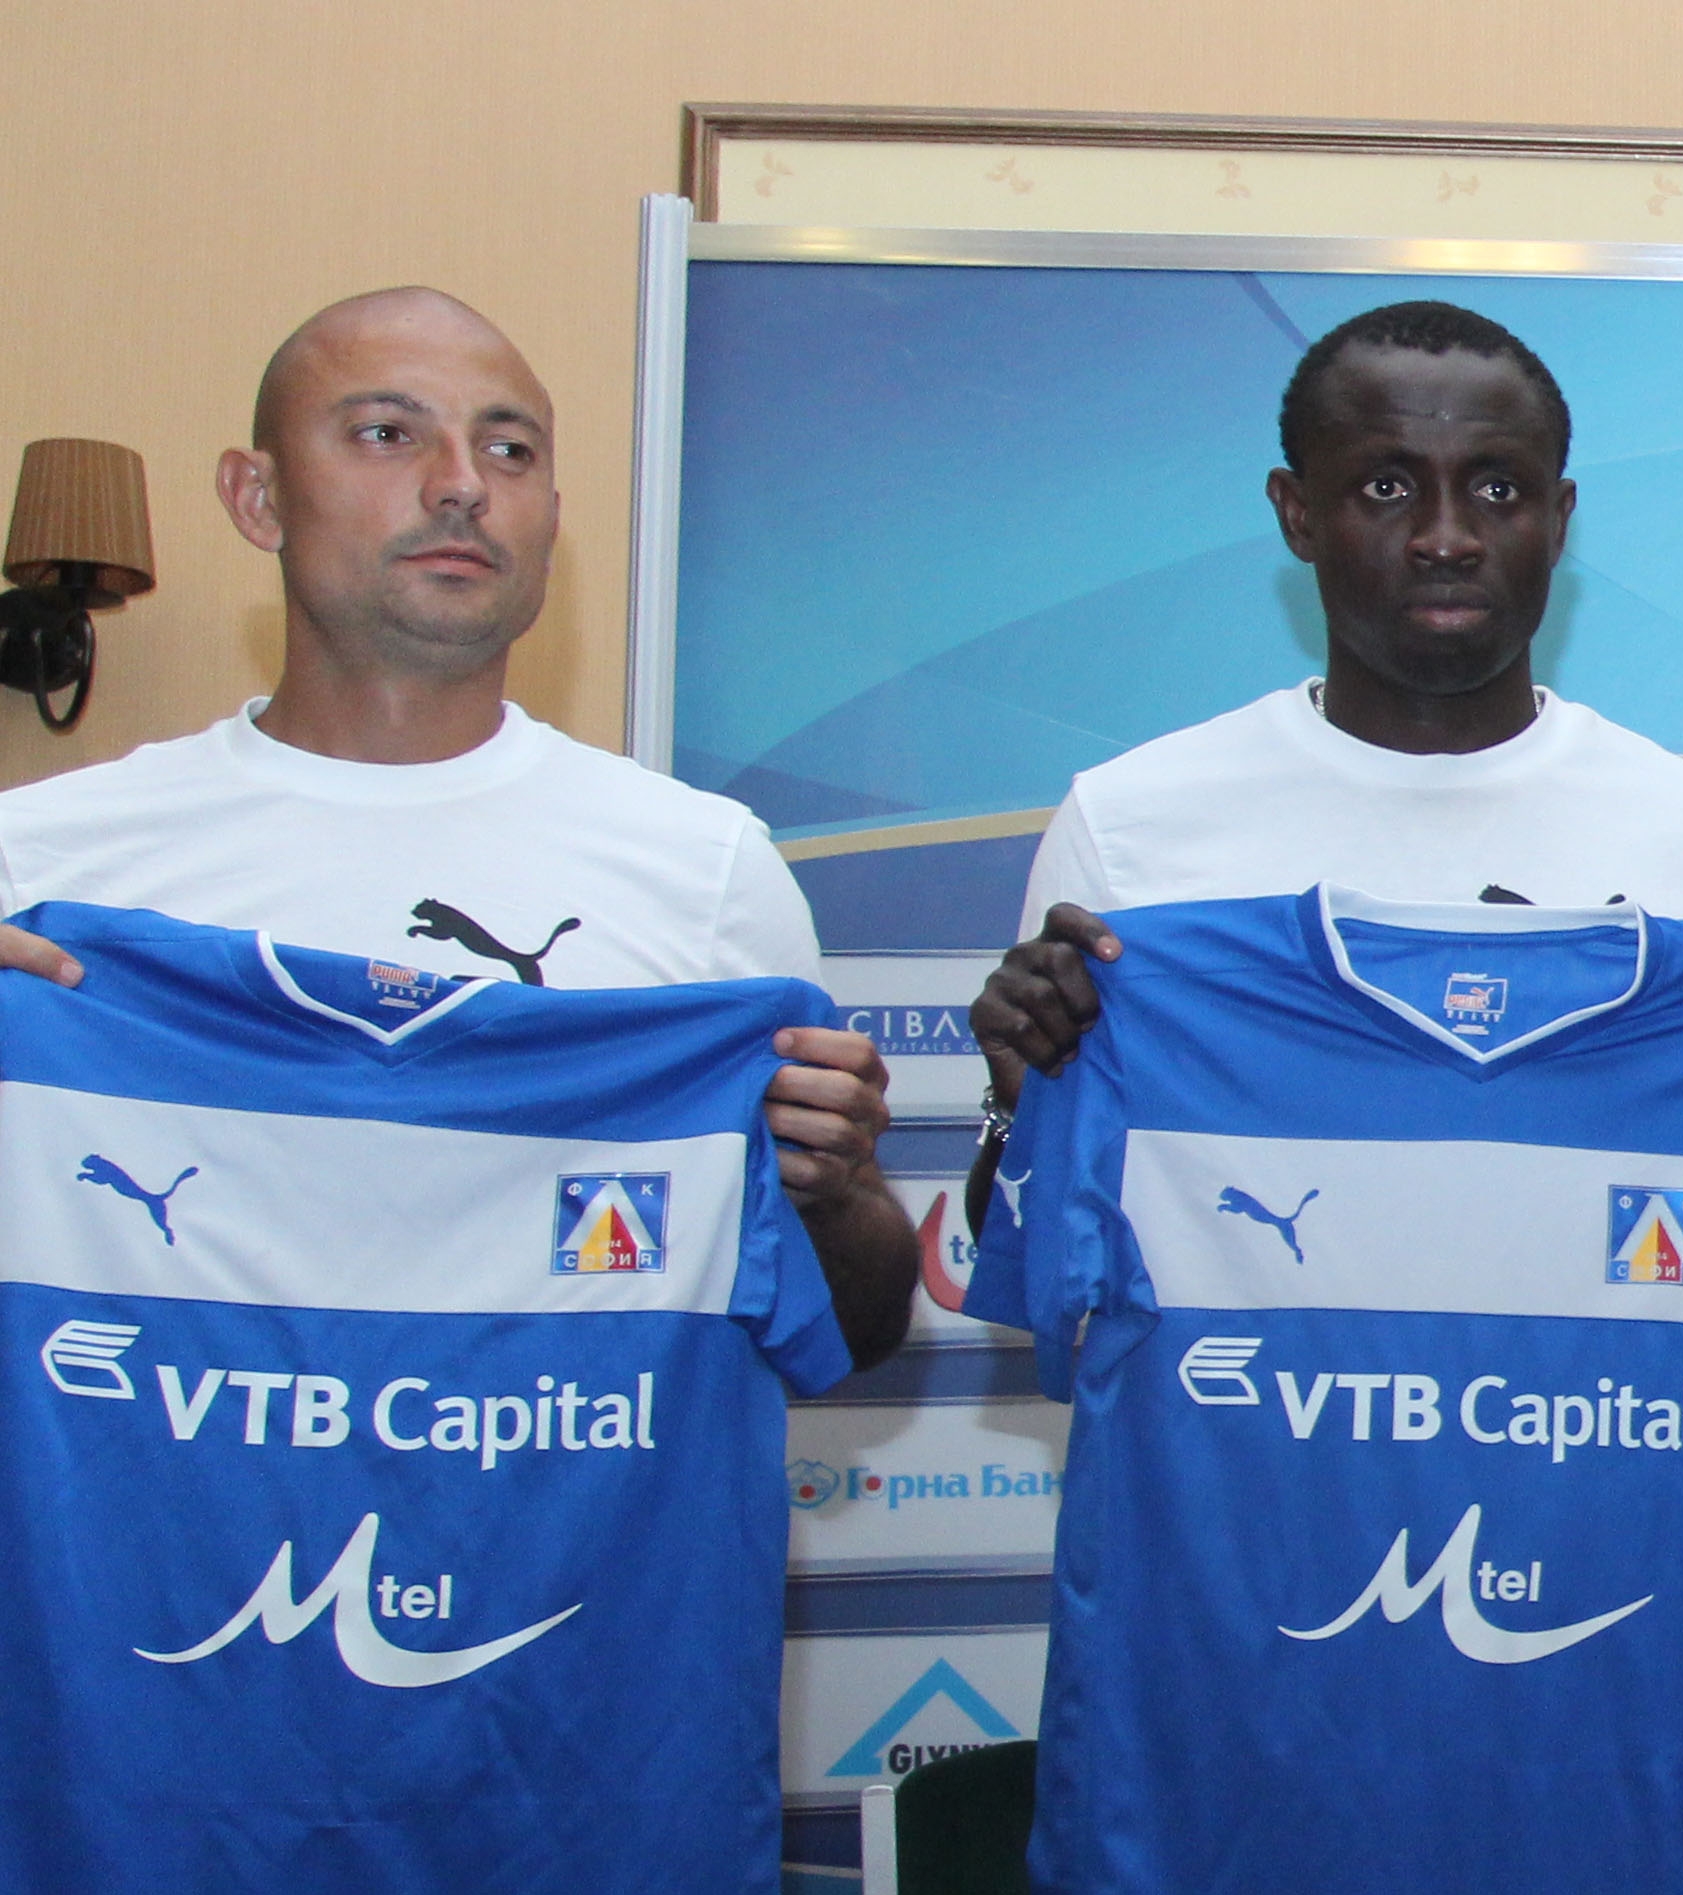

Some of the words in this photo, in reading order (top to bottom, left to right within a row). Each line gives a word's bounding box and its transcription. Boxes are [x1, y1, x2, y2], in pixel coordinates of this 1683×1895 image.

[847, 1010, 976, 1038] CIBA
[880, 1042, 951, 1053] SPITALS
[155, 1364, 350, 1448] VTB
[372, 1371, 655, 1471] Capital
[1275, 1371, 1442, 1441] VTB
[981, 1463, 1065, 1498] Бан
